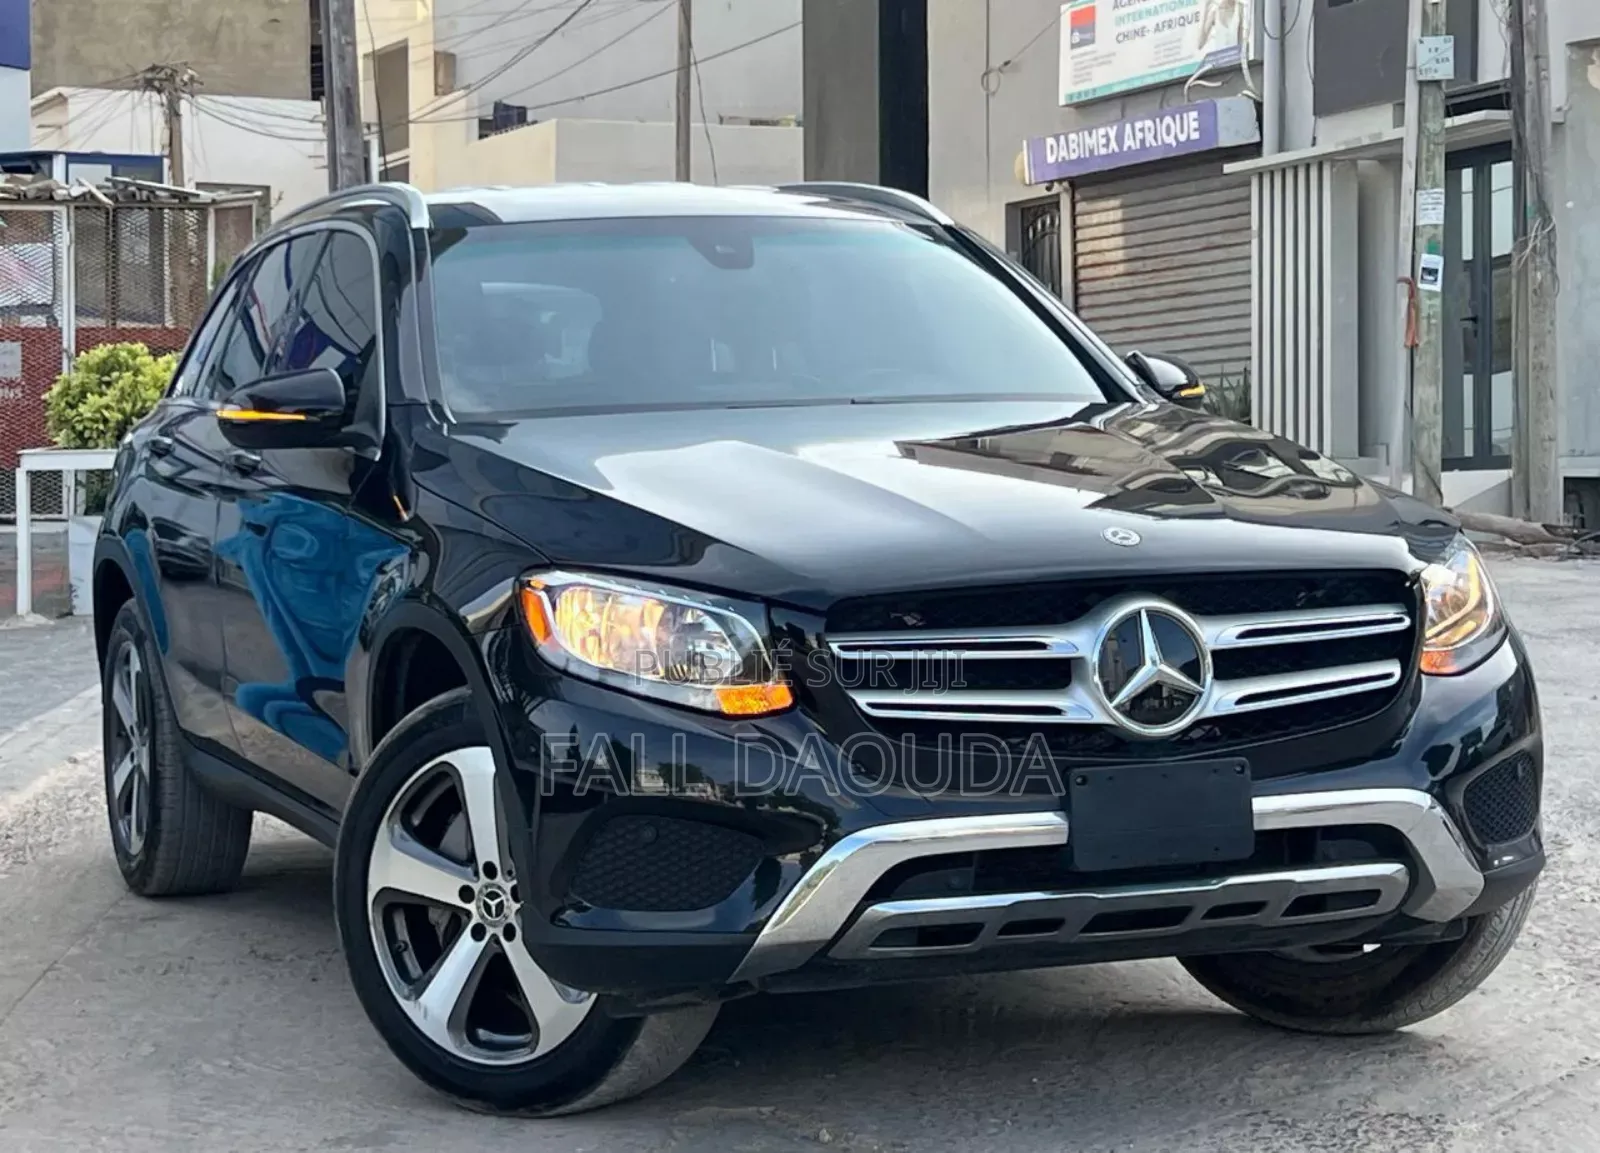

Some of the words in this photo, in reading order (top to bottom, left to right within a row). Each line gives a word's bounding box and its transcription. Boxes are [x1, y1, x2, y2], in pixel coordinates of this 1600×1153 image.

[1153, 11, 1201, 34] AFRIQUE
[1045, 125, 1120, 164] DABIMEX
[1123, 111, 1200, 152] AFRIQUE
